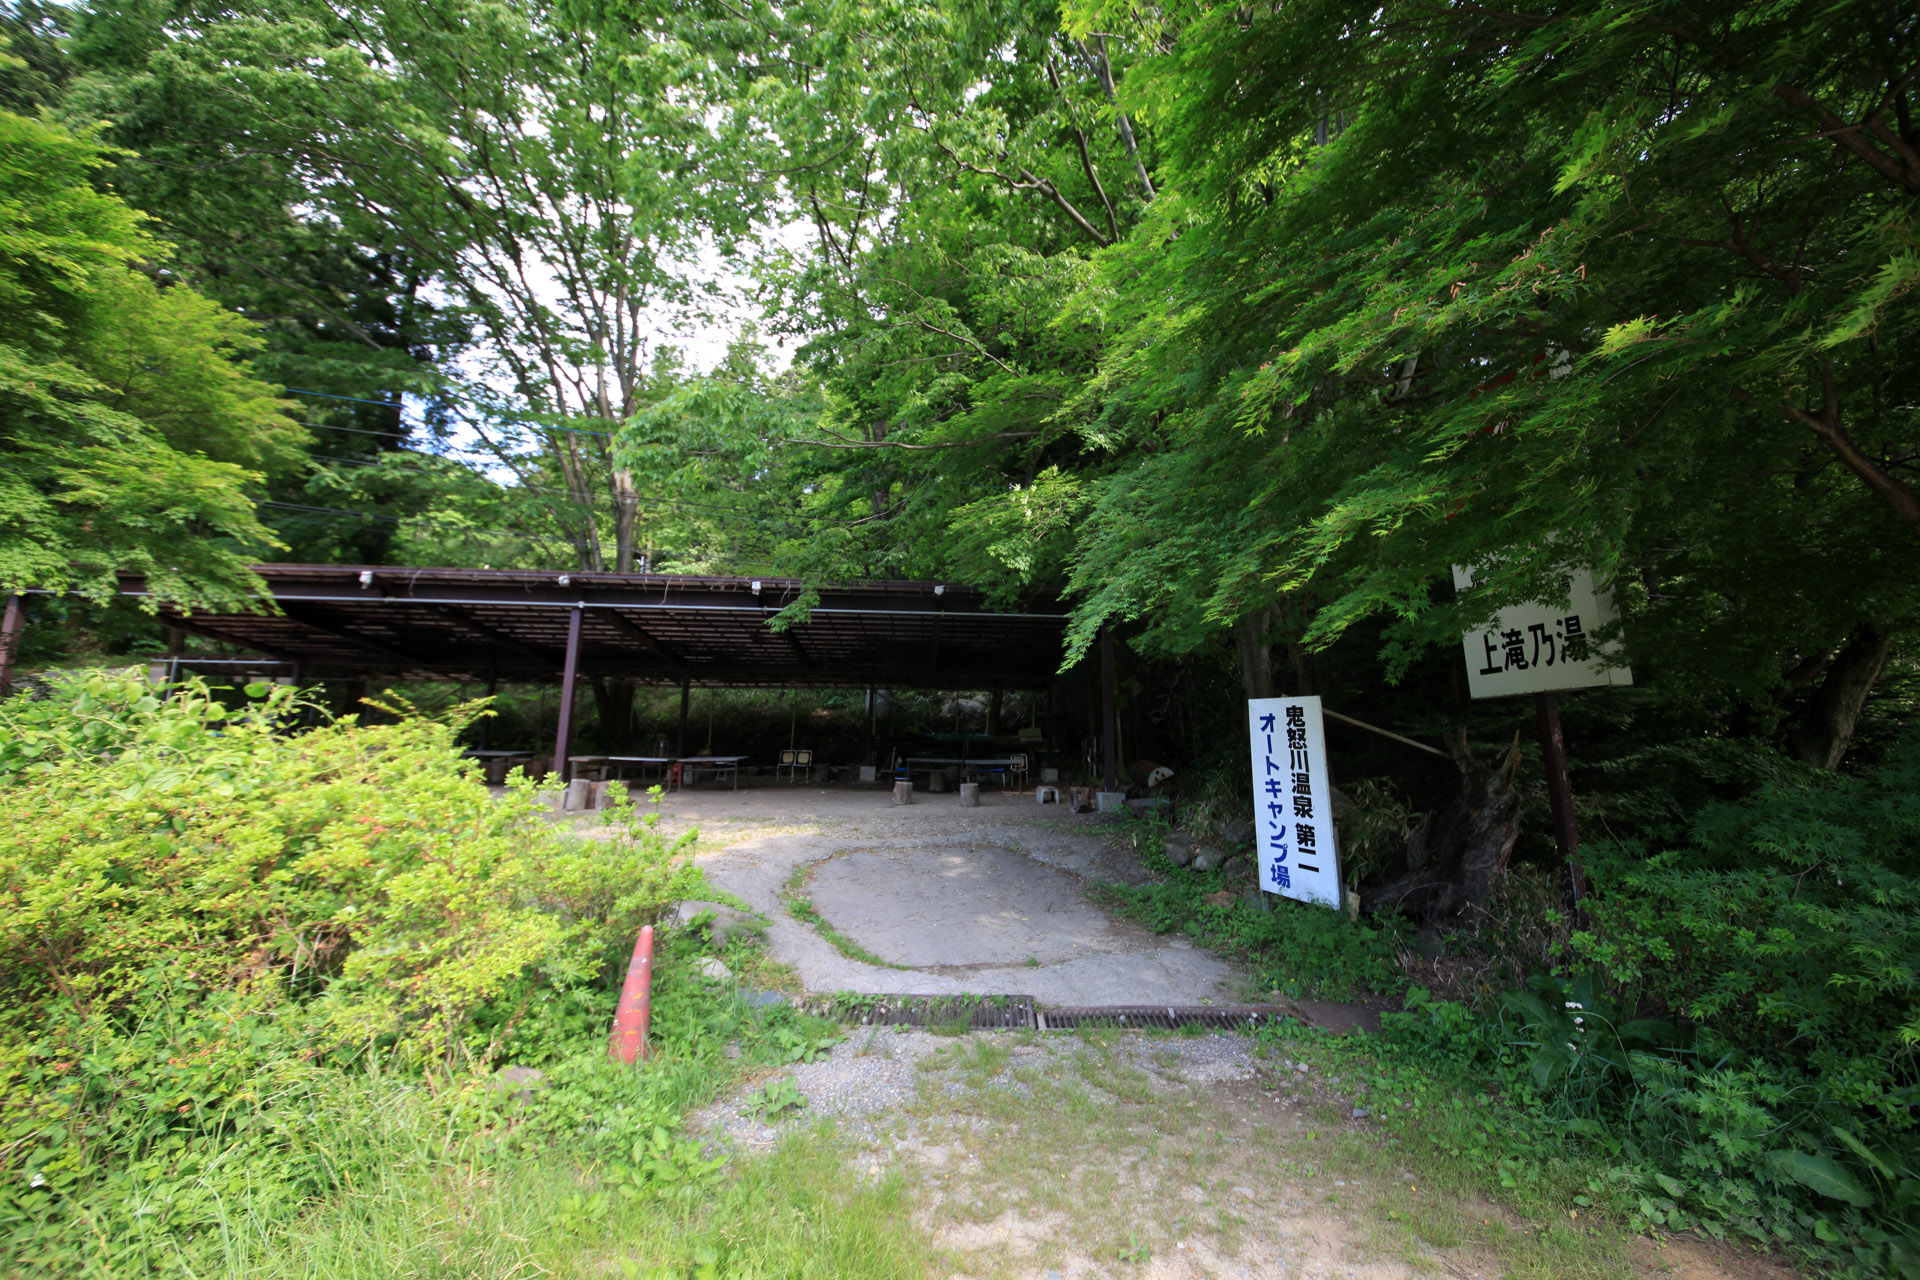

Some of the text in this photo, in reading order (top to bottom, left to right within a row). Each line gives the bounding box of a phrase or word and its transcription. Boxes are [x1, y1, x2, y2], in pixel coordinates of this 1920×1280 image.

[1480, 615, 1587, 675] 上滝乃湯
[1259, 713, 1291, 889] オートキャンプ場
